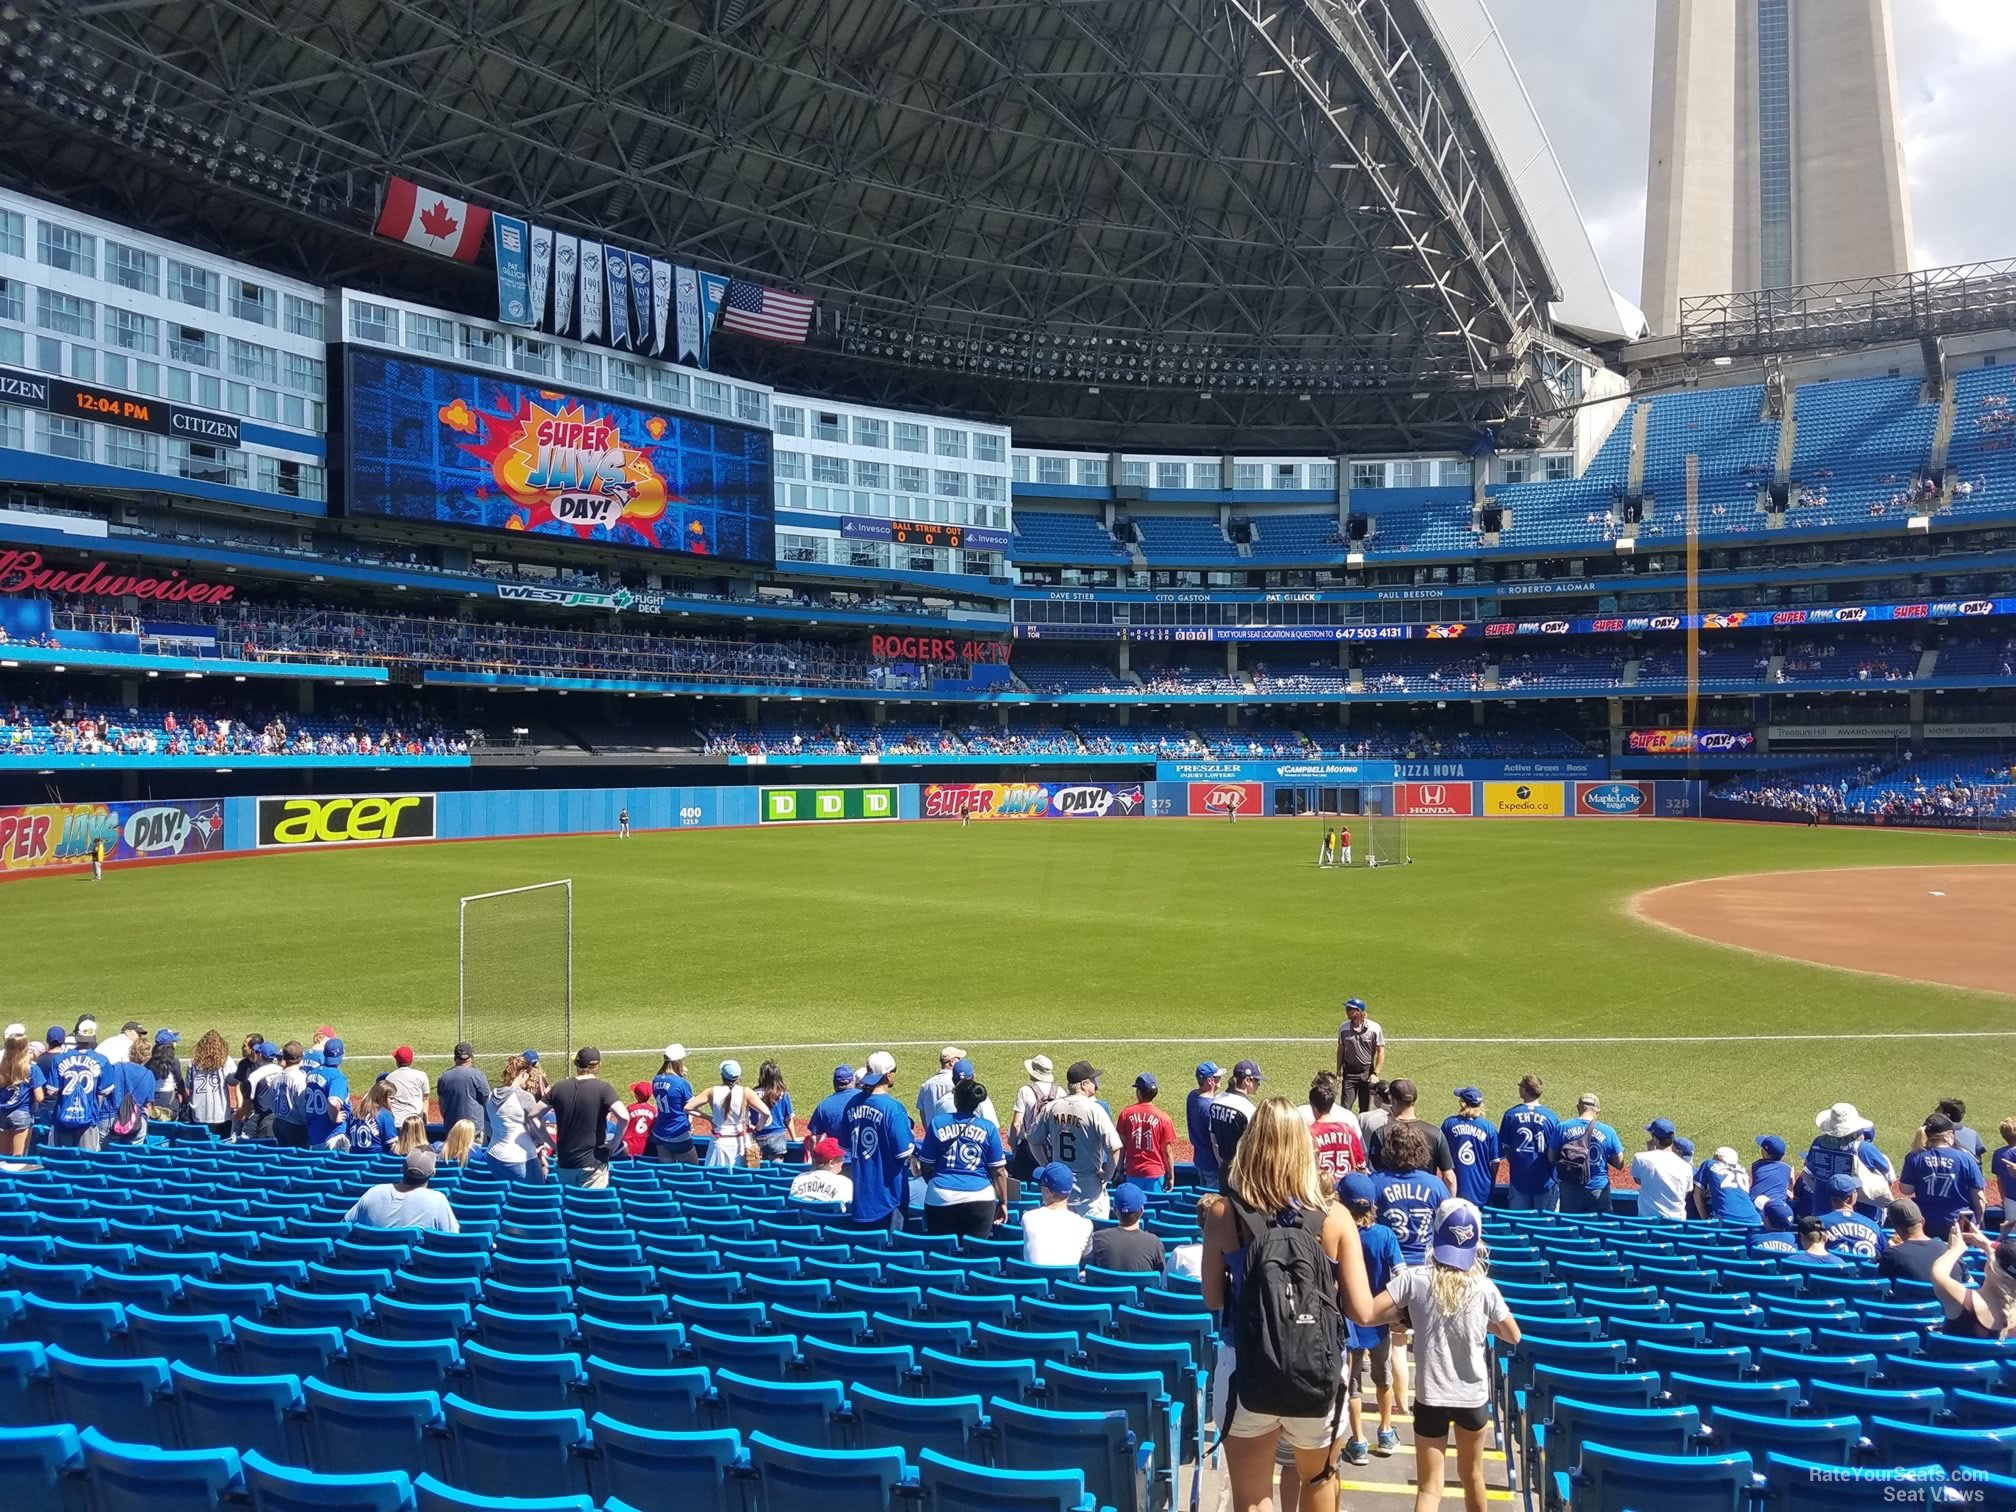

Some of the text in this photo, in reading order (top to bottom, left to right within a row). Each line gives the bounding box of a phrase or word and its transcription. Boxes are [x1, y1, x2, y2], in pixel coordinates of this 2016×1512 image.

[583, 277, 601, 293] 1991
[679, 301, 698, 316] 2016
[76, 393, 149, 422] 12:04 PM
[172, 413, 239, 439] CITIZEN
[536, 420, 612, 452] SUPER
[526, 446, 627, 493] JAYS
[558, 498, 614, 522] DAY!
[858, 522, 891, 535] Invesco
[892, 522, 962, 535] BALL STRIKE OUT
[897, 531, 959, 547] 0 0 0
[978, 534, 1009, 545] Invesco
[0, 550, 235, 605] Budweiser
[500, 586, 611, 605] WESTJET
[1050, 592, 1095, 601] DAVE STIEB
[1403, 590, 1444, 599] BEESTON
[1508, 583, 1596, 594] ROBERTO ALOMAR
[634, 595, 665, 605] FLIGHT
[1155, 594, 1211, 602] CITO GASTON
[638, 604, 661, 614] DECK
[1773, 611, 1807, 624] SUPER
[1839, 608, 1864, 619] DAY!
[1893, 604, 1929, 618] SUPER
[1963, 601, 1990, 613] DAY!
[1217, 627, 1402, 639] TEXT YOUR SEAT LOCATION & QUESTION TO 647 503 4131
[1485, 623, 1516, 636] SUPER
[1545, 622, 1567, 633] DAY!
[1593, 618, 1624, 632] SUPER
[1654, 616, 1678, 628] DAY!
[871, 634, 1013, 665] ROGERS 4K TV
[1630, 734, 1668, 749] SUPER
[1706, 735, 1732, 746] DAY!
[1176, 765, 1241, 773] PRESZLER
[1284, 765, 1358, 774] CAMPBELL MOVING
[1394, 764, 1464, 777] PIZZA NOVA
[1504, 763, 1588, 772] Active Green Ross
[772, 795, 795, 814] TD
[818, 795, 842, 813] TD
[866, 793, 888, 811] TD
[926, 786, 1109, 817] SUPER JAYS DAY!
[1151, 799, 1172, 809] 375
[1211, 791, 1241, 807] DQ
[1498, 801, 1549, 812] Expedia.ca
[1665, 798, 1690, 809] 328
[273, 797, 420, 844] acer
[680, 807, 702, 818] 400
[1892, 816, 1913, 825] North
[1913, 817, 1945, 826] America's
[53, 811, 120, 858] JAYS
[135, 808, 186, 847] DAY!
[62, 1070, 95, 1095] 20
[194, 1072, 219, 1095] 29
[305, 1087, 329, 1116] 20
[656, 1094, 671, 1114] 11
[1053, 1113, 1083, 1129] MARTE
[1128, 1112, 1160, 1128] PILLAR
[1211, 1105, 1237, 1123] STAFF
[635, 1117, 648, 1134] 6
[937, 1122, 987, 1143] BAUTISTA
[1451, 1123, 1487, 1143] STROMAN
[350, 1124, 372, 1149] 10
[850, 1125, 879, 1160] 19
[1131, 1127, 1155, 1152] 11
[1516, 1127, 1545, 1153] 21
[946, 1140, 983, 1171] 19
[1059, 1131, 1076, 1163] 6
[1458, 1140, 1476, 1166] 6
[1319, 1150, 1352, 1179] 55
[797, 1180, 838, 1200] STROMAN
[1383, 1183, 1431, 1204] GRILLI
[1922, 1172, 1956, 1198] 17
[1383, 1207, 1435, 1243] 37
[1826, 1222, 1878, 1245] BAUTISTA
